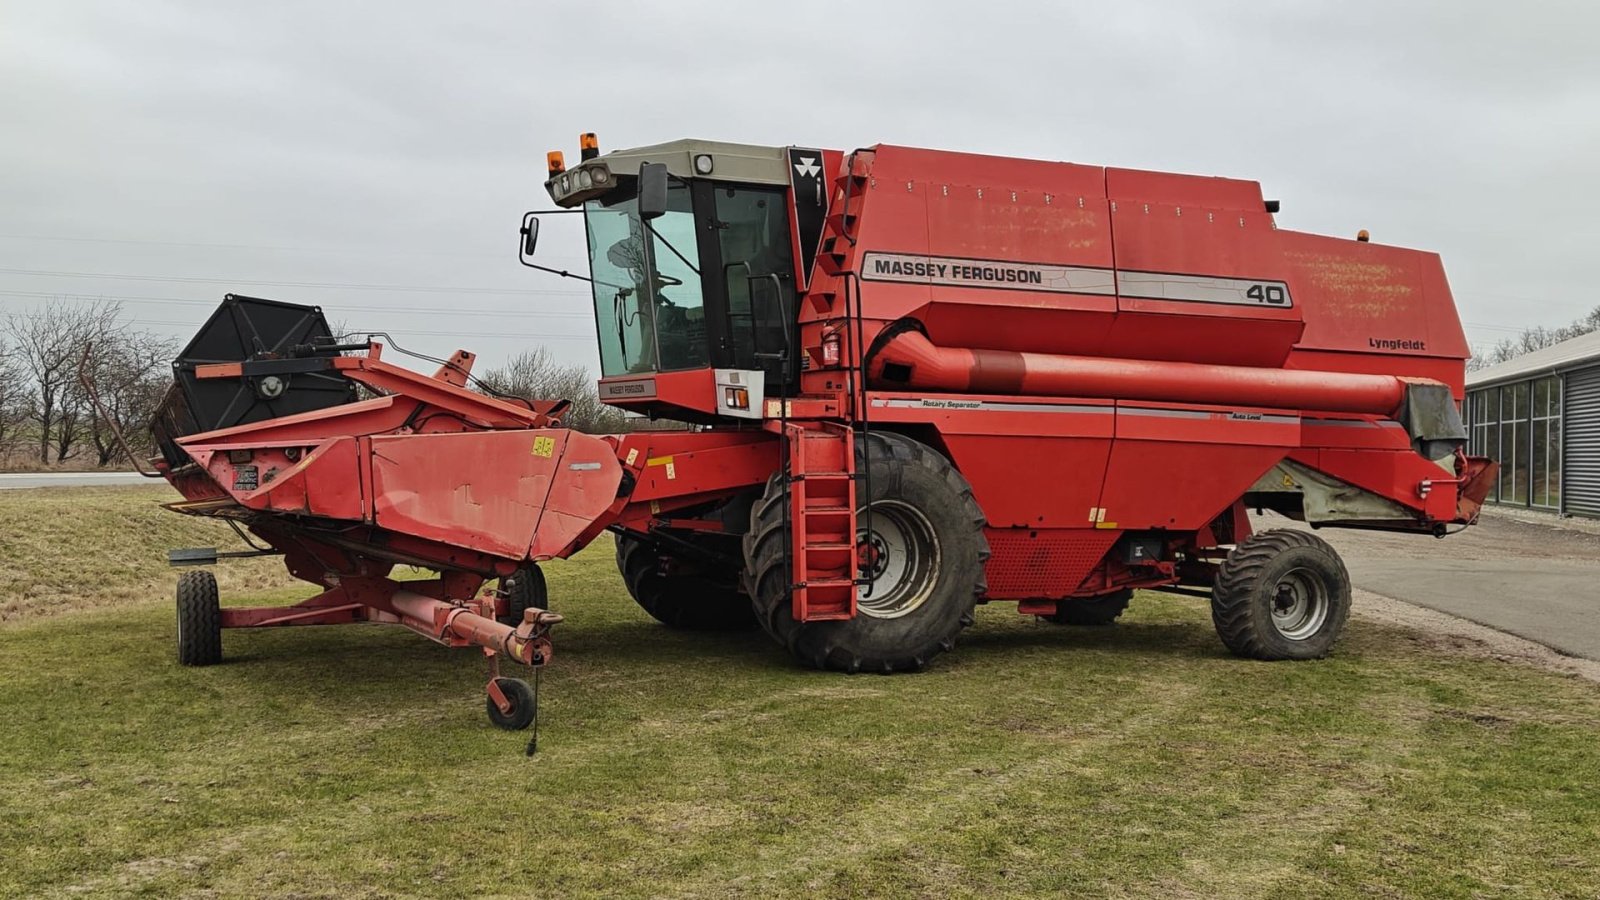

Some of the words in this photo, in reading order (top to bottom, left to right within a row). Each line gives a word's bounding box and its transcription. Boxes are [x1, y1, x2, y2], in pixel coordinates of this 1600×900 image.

[875, 260, 947, 278] MASSEY
[952, 265, 1042, 284] FERGUSON
[1247, 285, 1285, 304] 40
[1369, 338, 1425, 350] Lyngfeldt
[923, 400, 946, 408] Rotary
